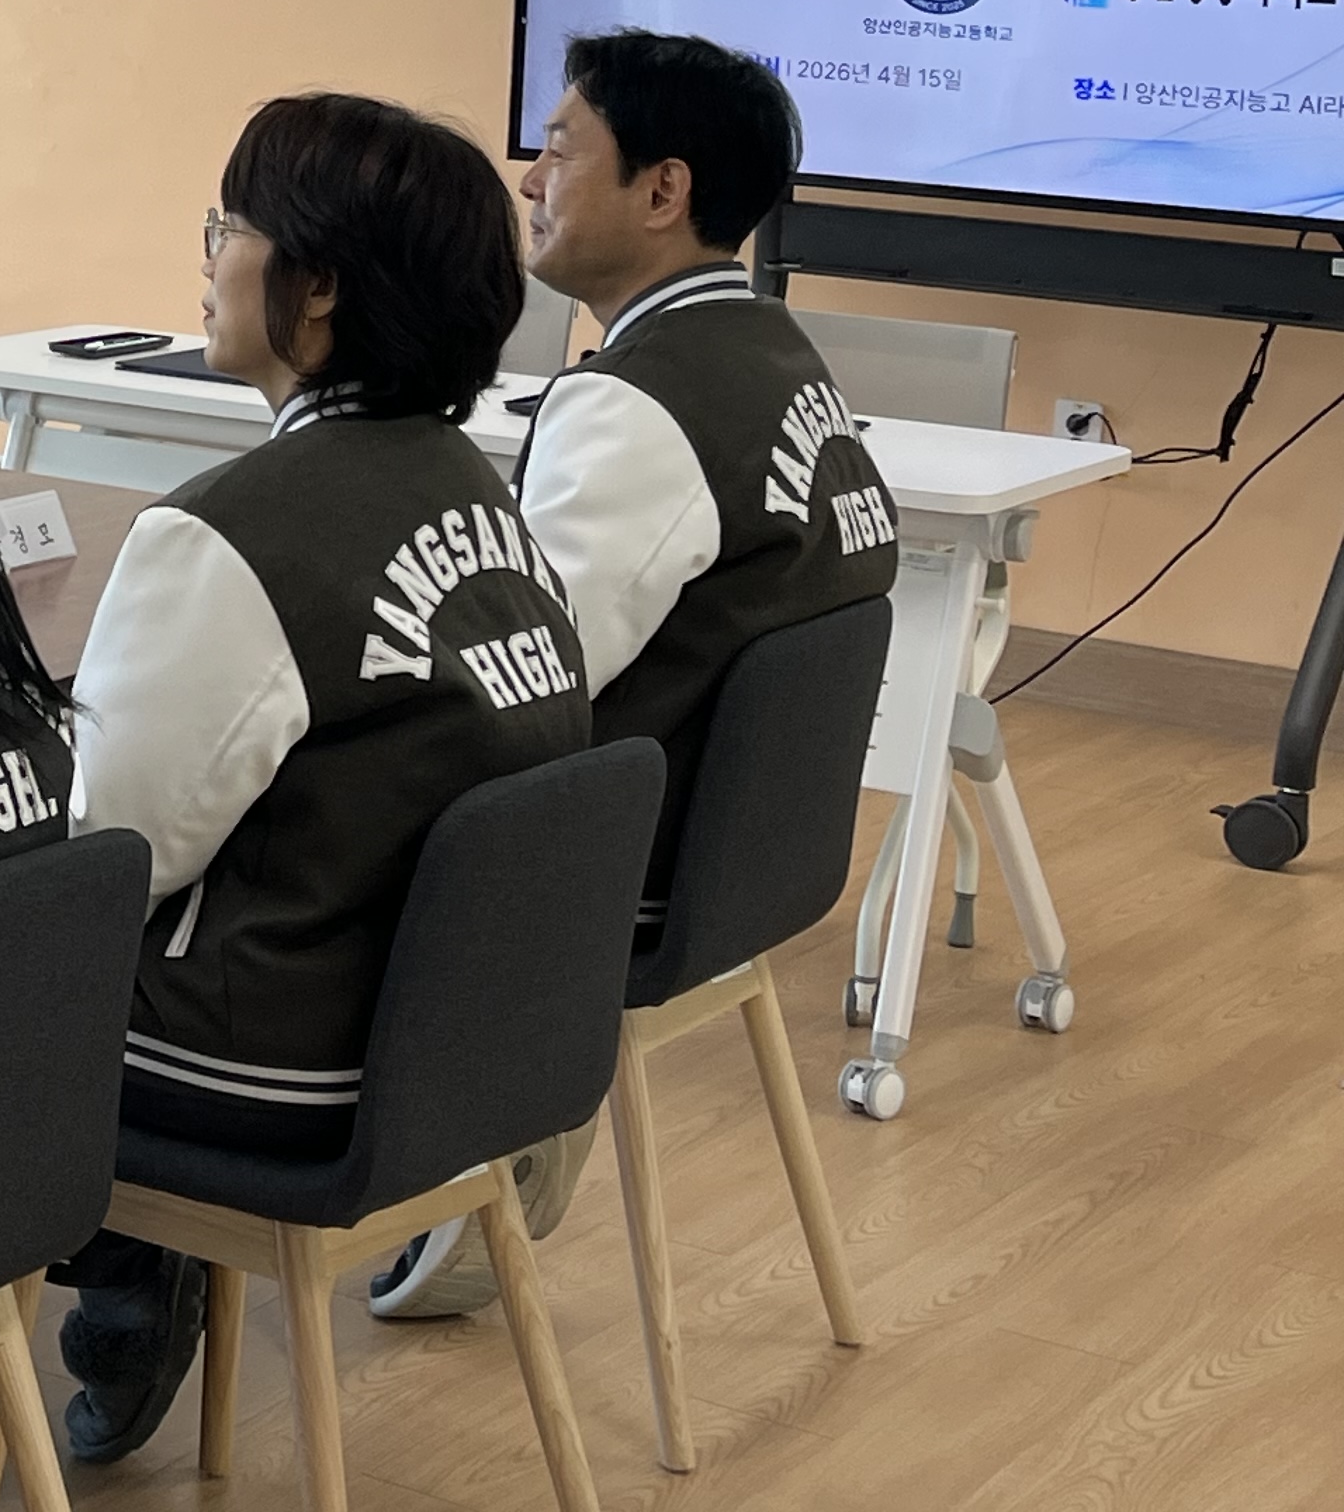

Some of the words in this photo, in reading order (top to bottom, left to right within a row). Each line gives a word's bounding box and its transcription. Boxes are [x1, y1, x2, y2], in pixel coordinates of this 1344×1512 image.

[863, 17, 1014, 42] 양산인공지능고등학교
[797, 60, 871, 84] 2026년
[877, 65, 911, 88] 4월
[918, 68, 962, 92] 15일
[1073, 77, 1116, 101] 장소
[1135, 82, 1292, 113] 양산인공지능고
[358, 503, 530, 683] YANGSAN
[459, 625, 578, 710] HIGH.
